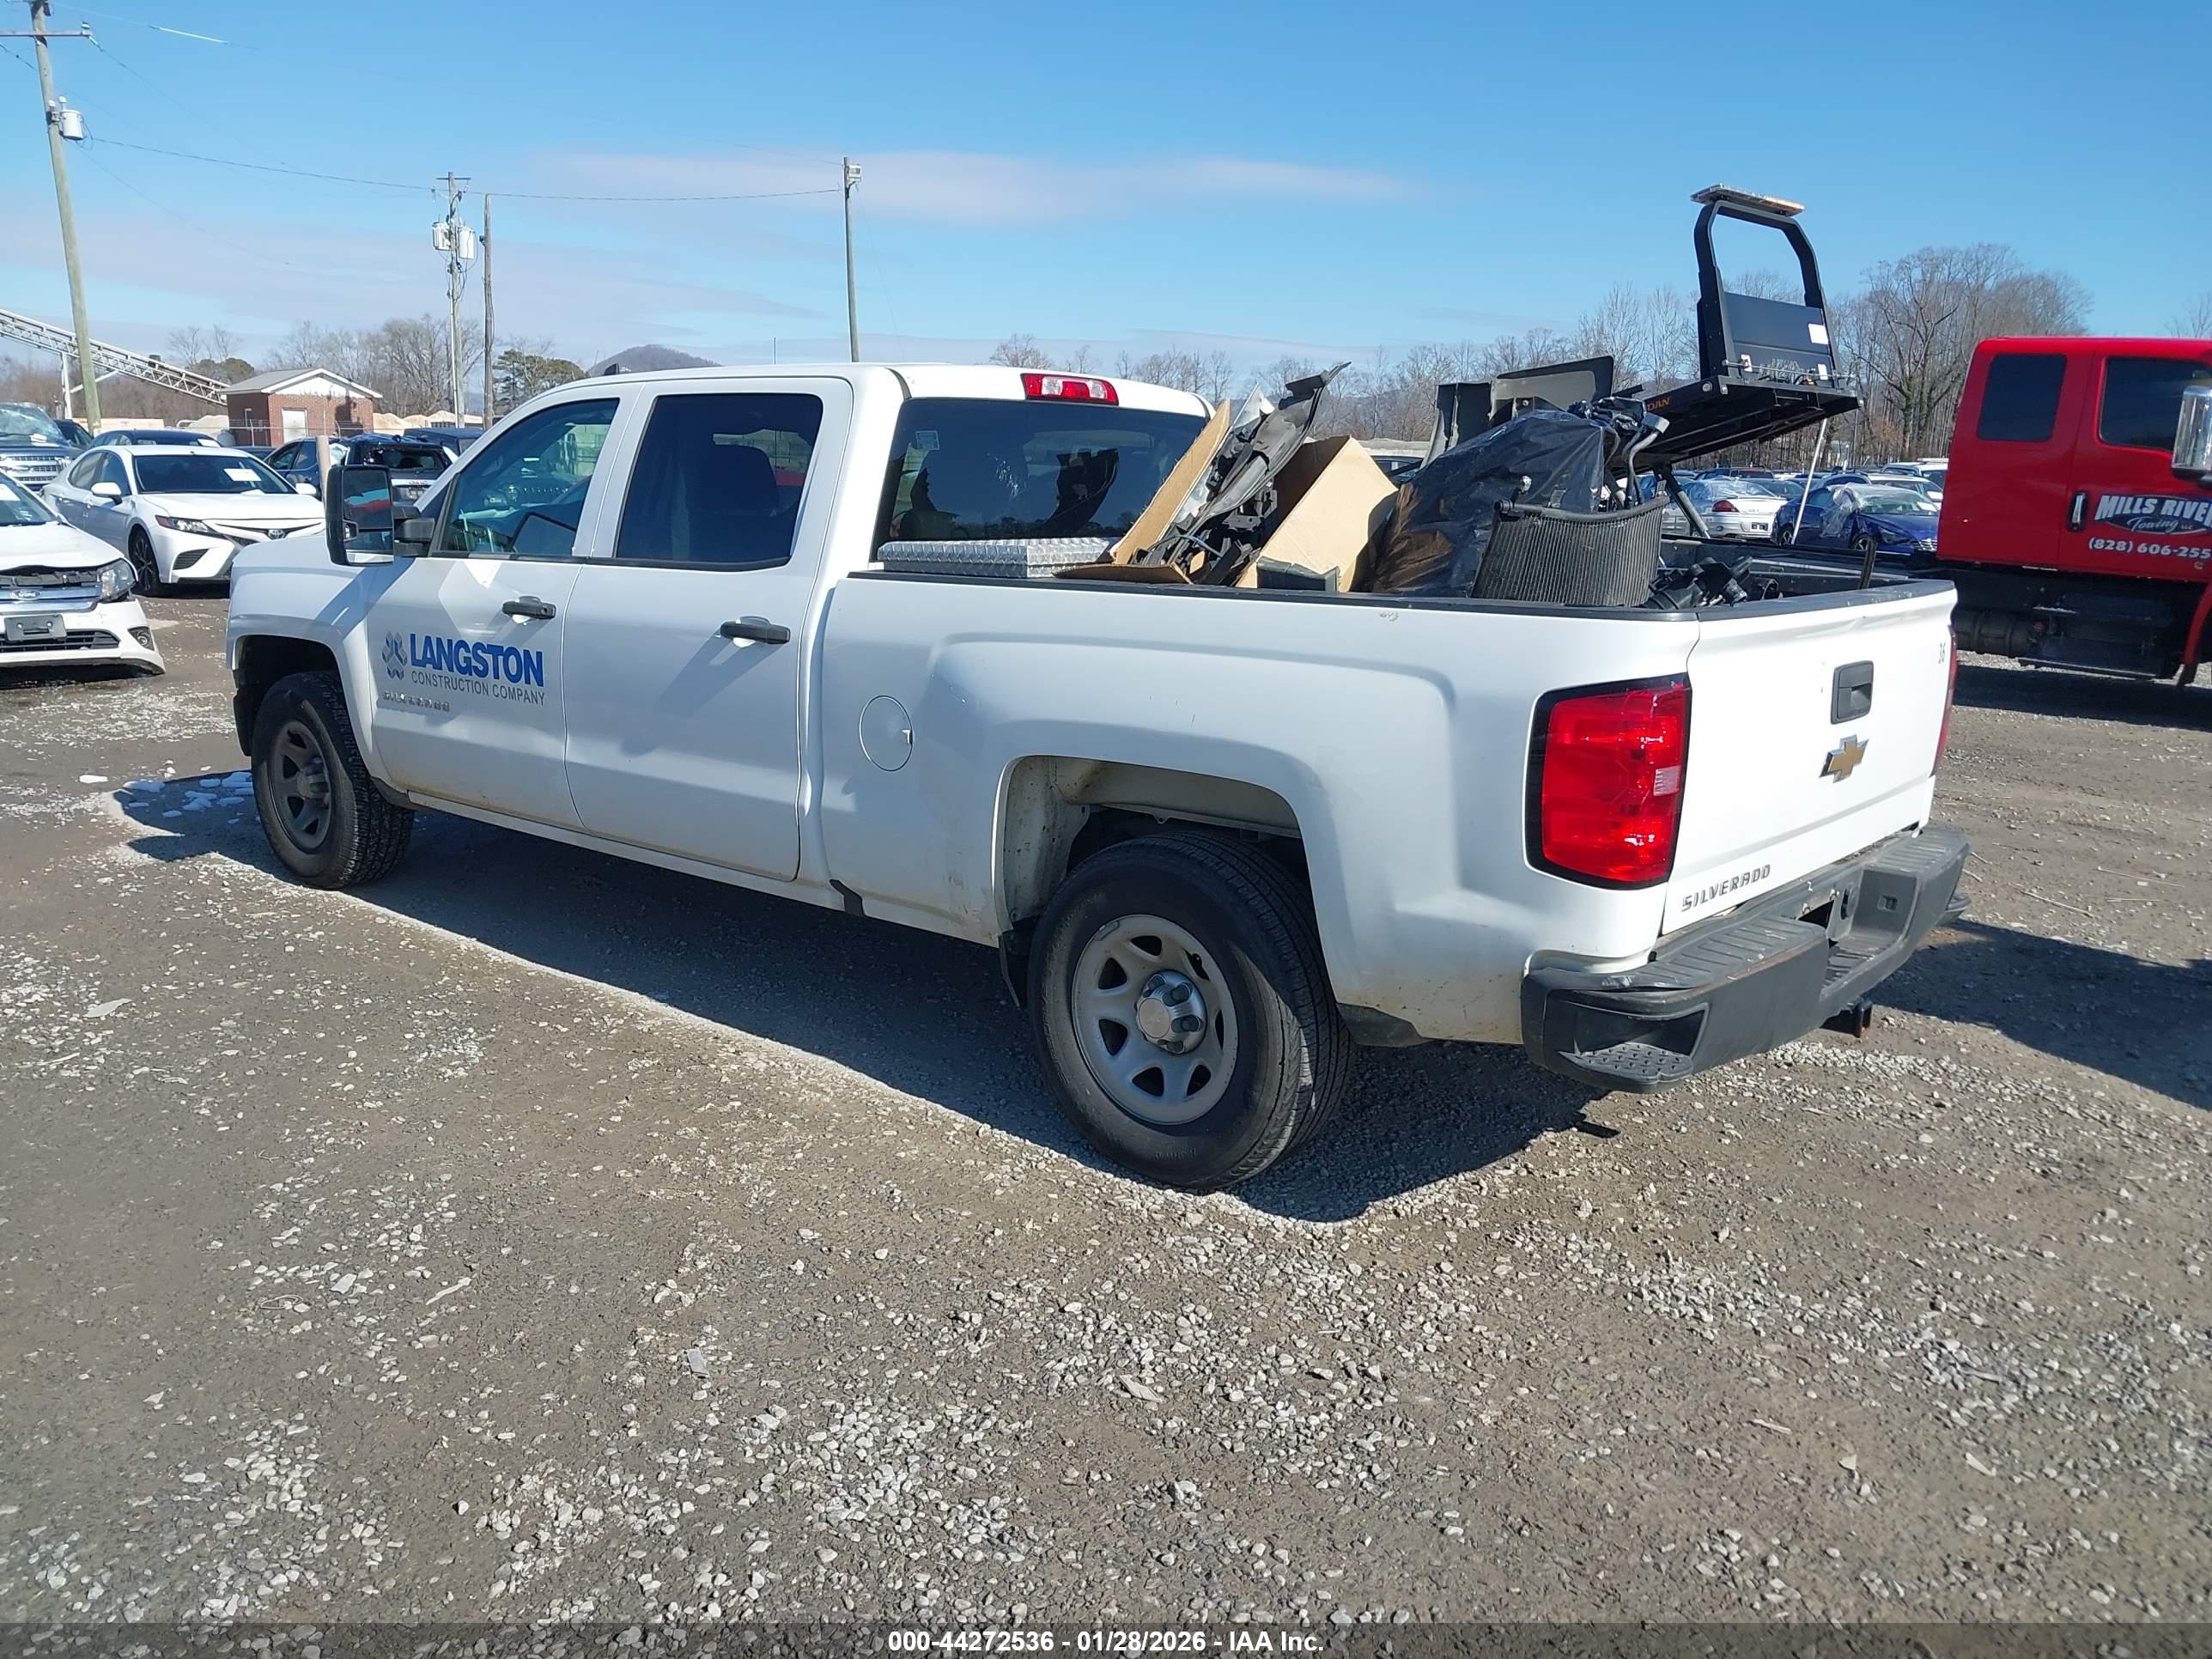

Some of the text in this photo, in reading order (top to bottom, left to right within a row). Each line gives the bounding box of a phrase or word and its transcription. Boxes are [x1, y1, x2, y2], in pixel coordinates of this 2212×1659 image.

[2094, 495, 2158, 520] MILLS
[2126, 516, 2179, 532] Towing
[2088, 537, 2212, 559] (828) 606-255
[410, 633, 544, 687] LANGSTON
[411, 671, 545, 706] CONSTRUCTION COMPANY
[1680, 864, 1771, 912] SILVERADO
